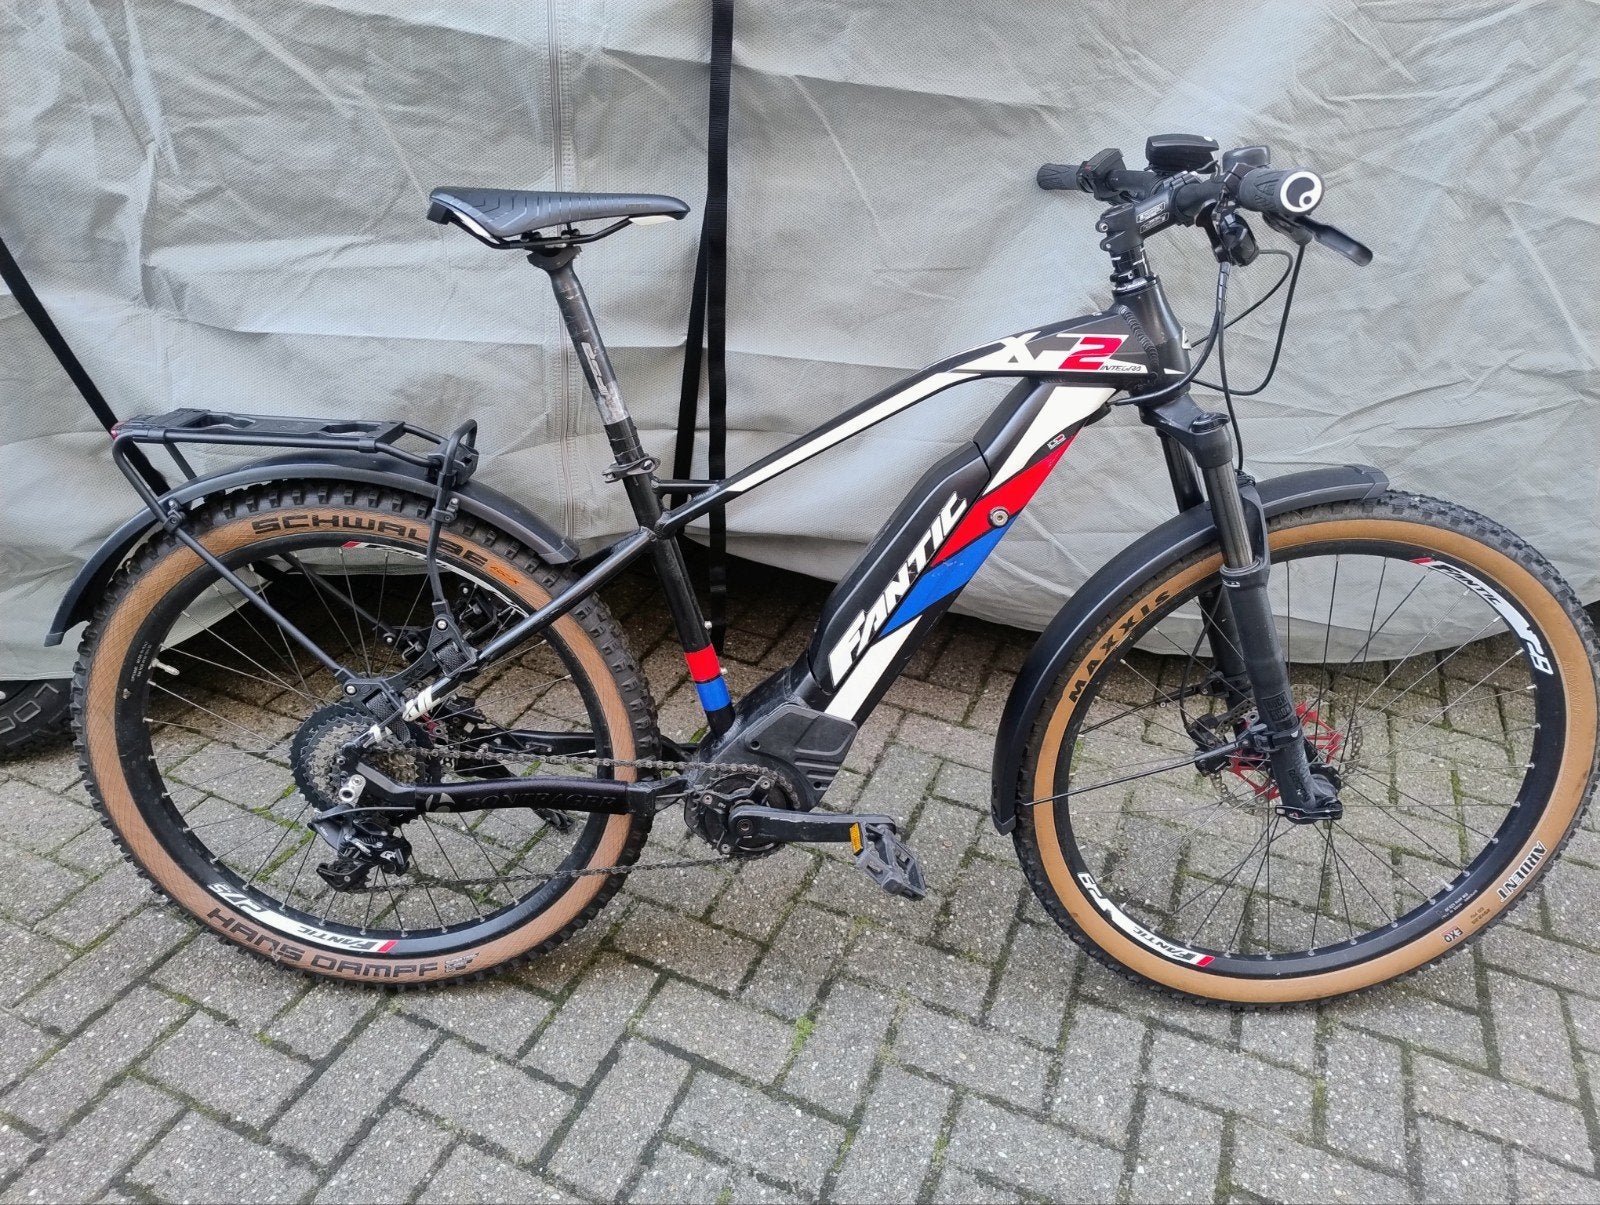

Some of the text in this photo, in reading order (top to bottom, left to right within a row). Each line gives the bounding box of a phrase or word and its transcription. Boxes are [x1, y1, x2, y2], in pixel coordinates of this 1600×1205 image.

[828, 491, 967, 689] FANTIC
[1432, 564, 1501, 605] FANTIC
[1069, 590, 1171, 703] MAXXIS
[1497, 840, 1547, 902] ARDENT
[207, 908, 305, 962] HANS
[311, 953, 438, 978] DAMPF
[298, 925, 380, 951] FANTIC
[1133, 927, 1198, 961] FANTIC
[1444, 926, 1464, 943] EXO
